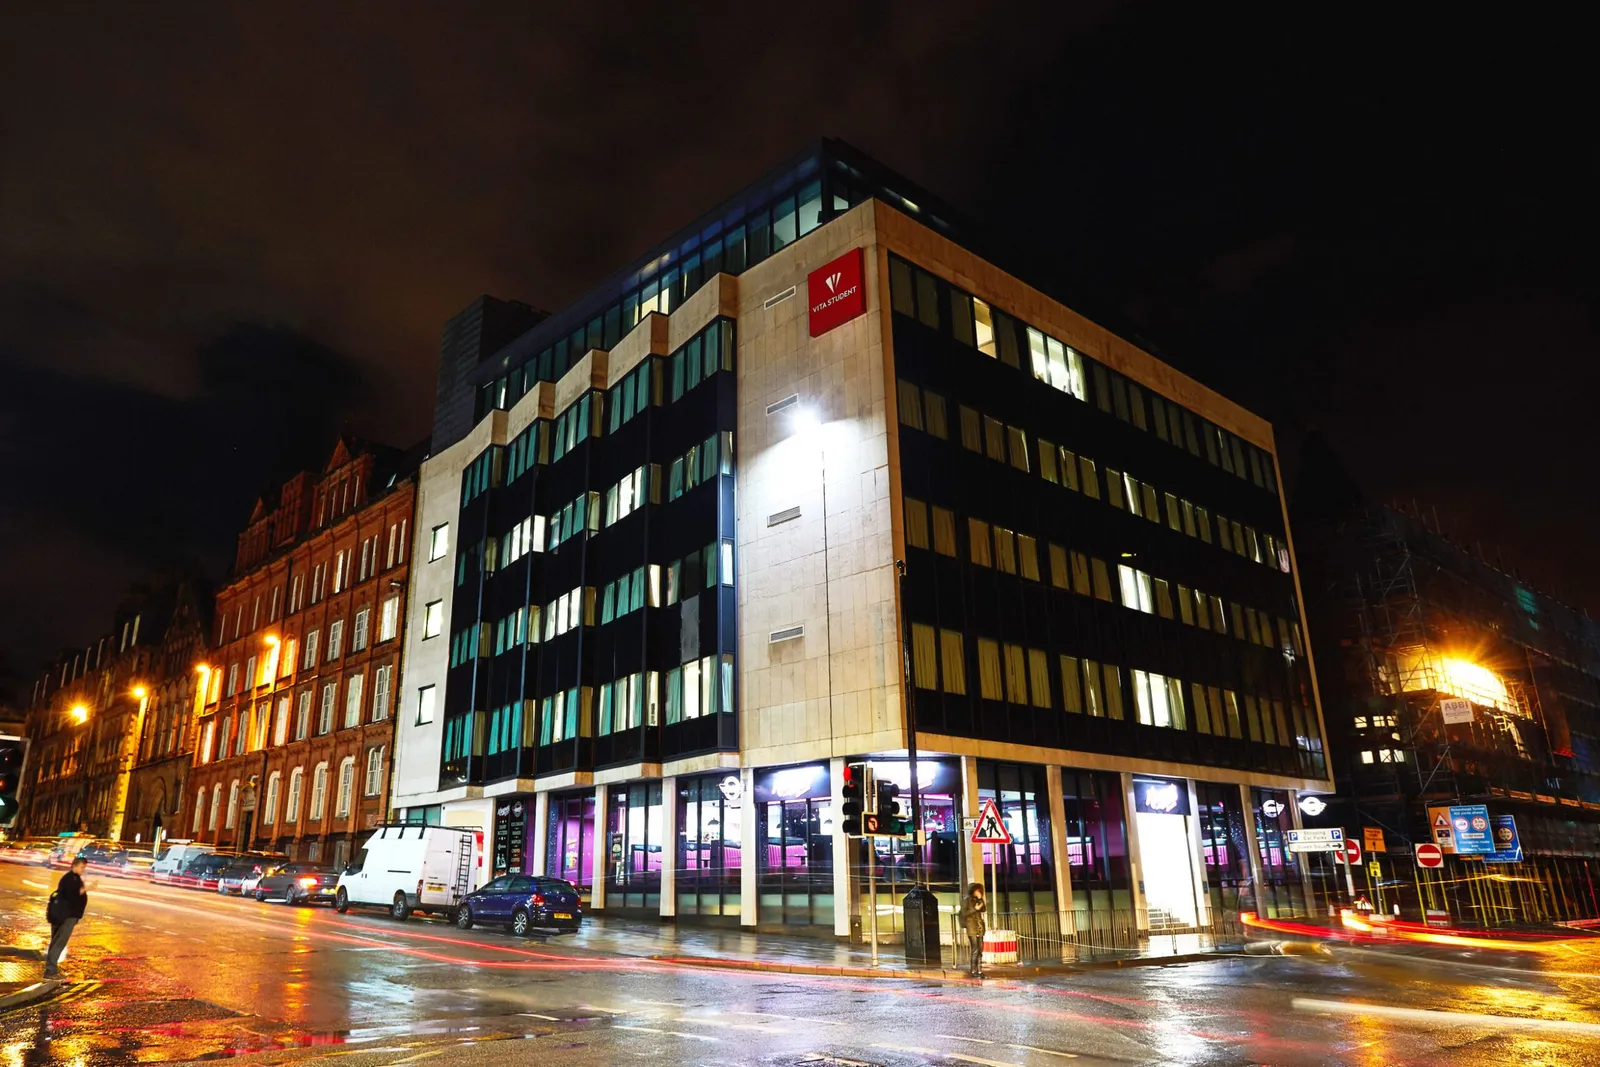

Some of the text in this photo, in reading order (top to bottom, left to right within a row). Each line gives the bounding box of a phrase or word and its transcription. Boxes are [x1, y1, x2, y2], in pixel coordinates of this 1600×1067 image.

[812, 286, 857, 313] VITA STUDENT
[1445, 701, 1468, 710] ABBI
